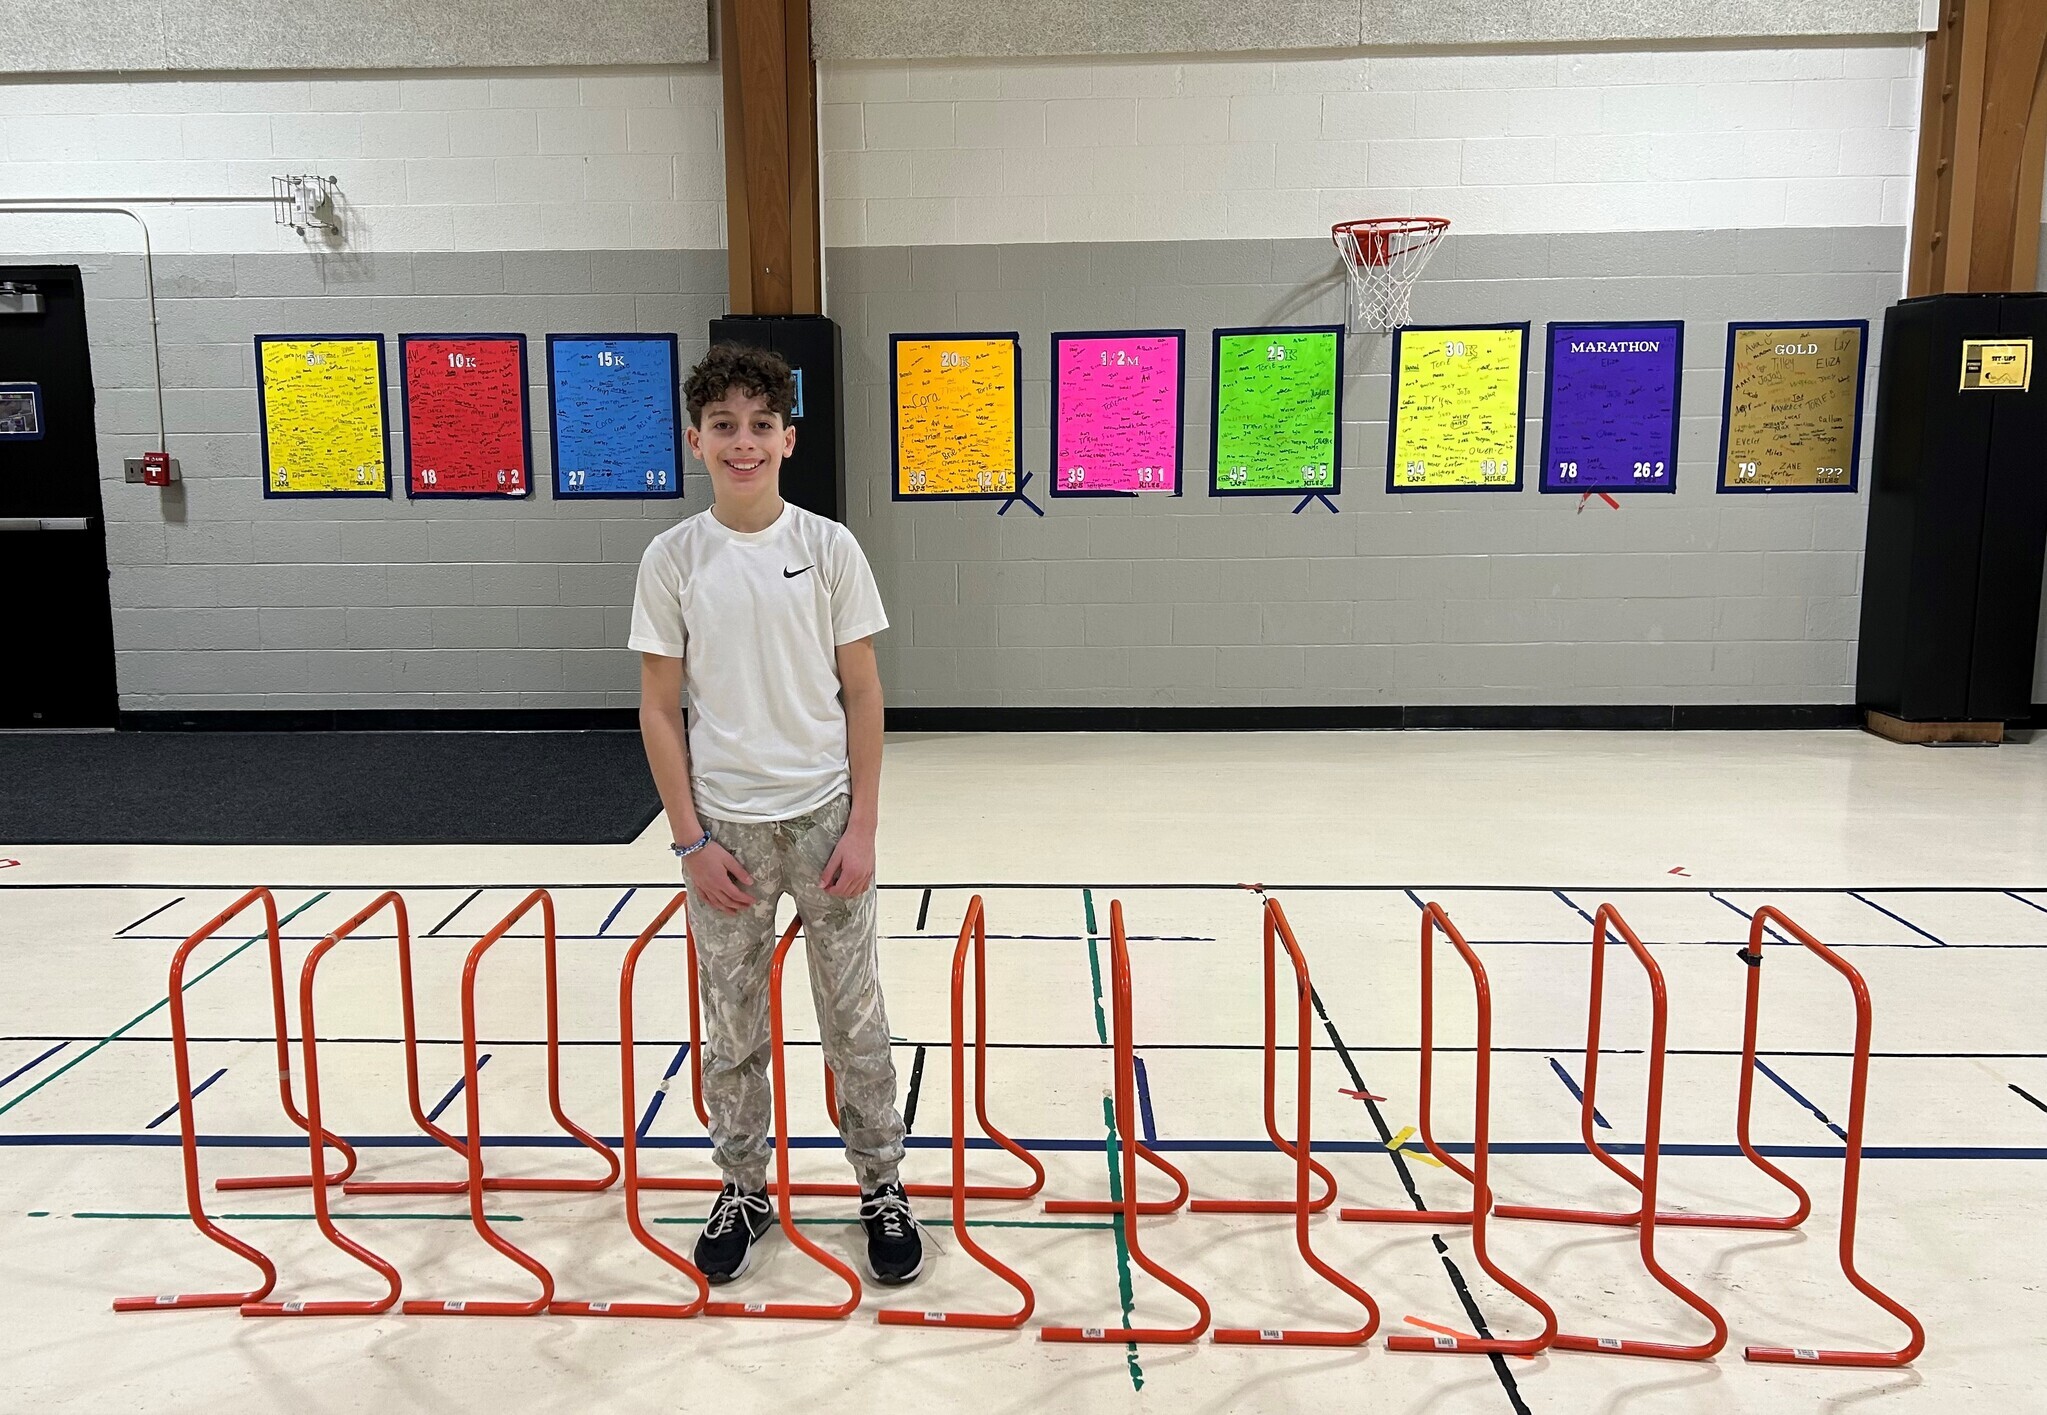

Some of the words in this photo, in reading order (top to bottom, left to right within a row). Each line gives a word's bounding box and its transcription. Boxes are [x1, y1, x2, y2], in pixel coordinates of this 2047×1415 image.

[1266, 344, 1298, 361] 25K
[1445, 341, 1478, 357] 30K
[1570, 341, 1660, 353] MARATHON
[1775, 343, 1818, 355] GOLD
[447, 353, 477, 368] 10K
[598, 351, 624, 367] 15K
[941, 351, 971, 367] 20K
[912, 393, 941, 408] Cora
[1068, 467, 1085, 483] 39
[1229, 466, 1247, 481] 45
[1407, 460, 1425, 476] 54
[1559, 462, 1578, 478] 78
[1633, 461, 1664, 478] 26.2
[1738, 462, 1756, 478] 79
[1816, 467, 1844, 478] ???
[421, 469, 437, 484] 18
[568, 470, 585, 486] 27
[909, 470, 927, 486] 36
